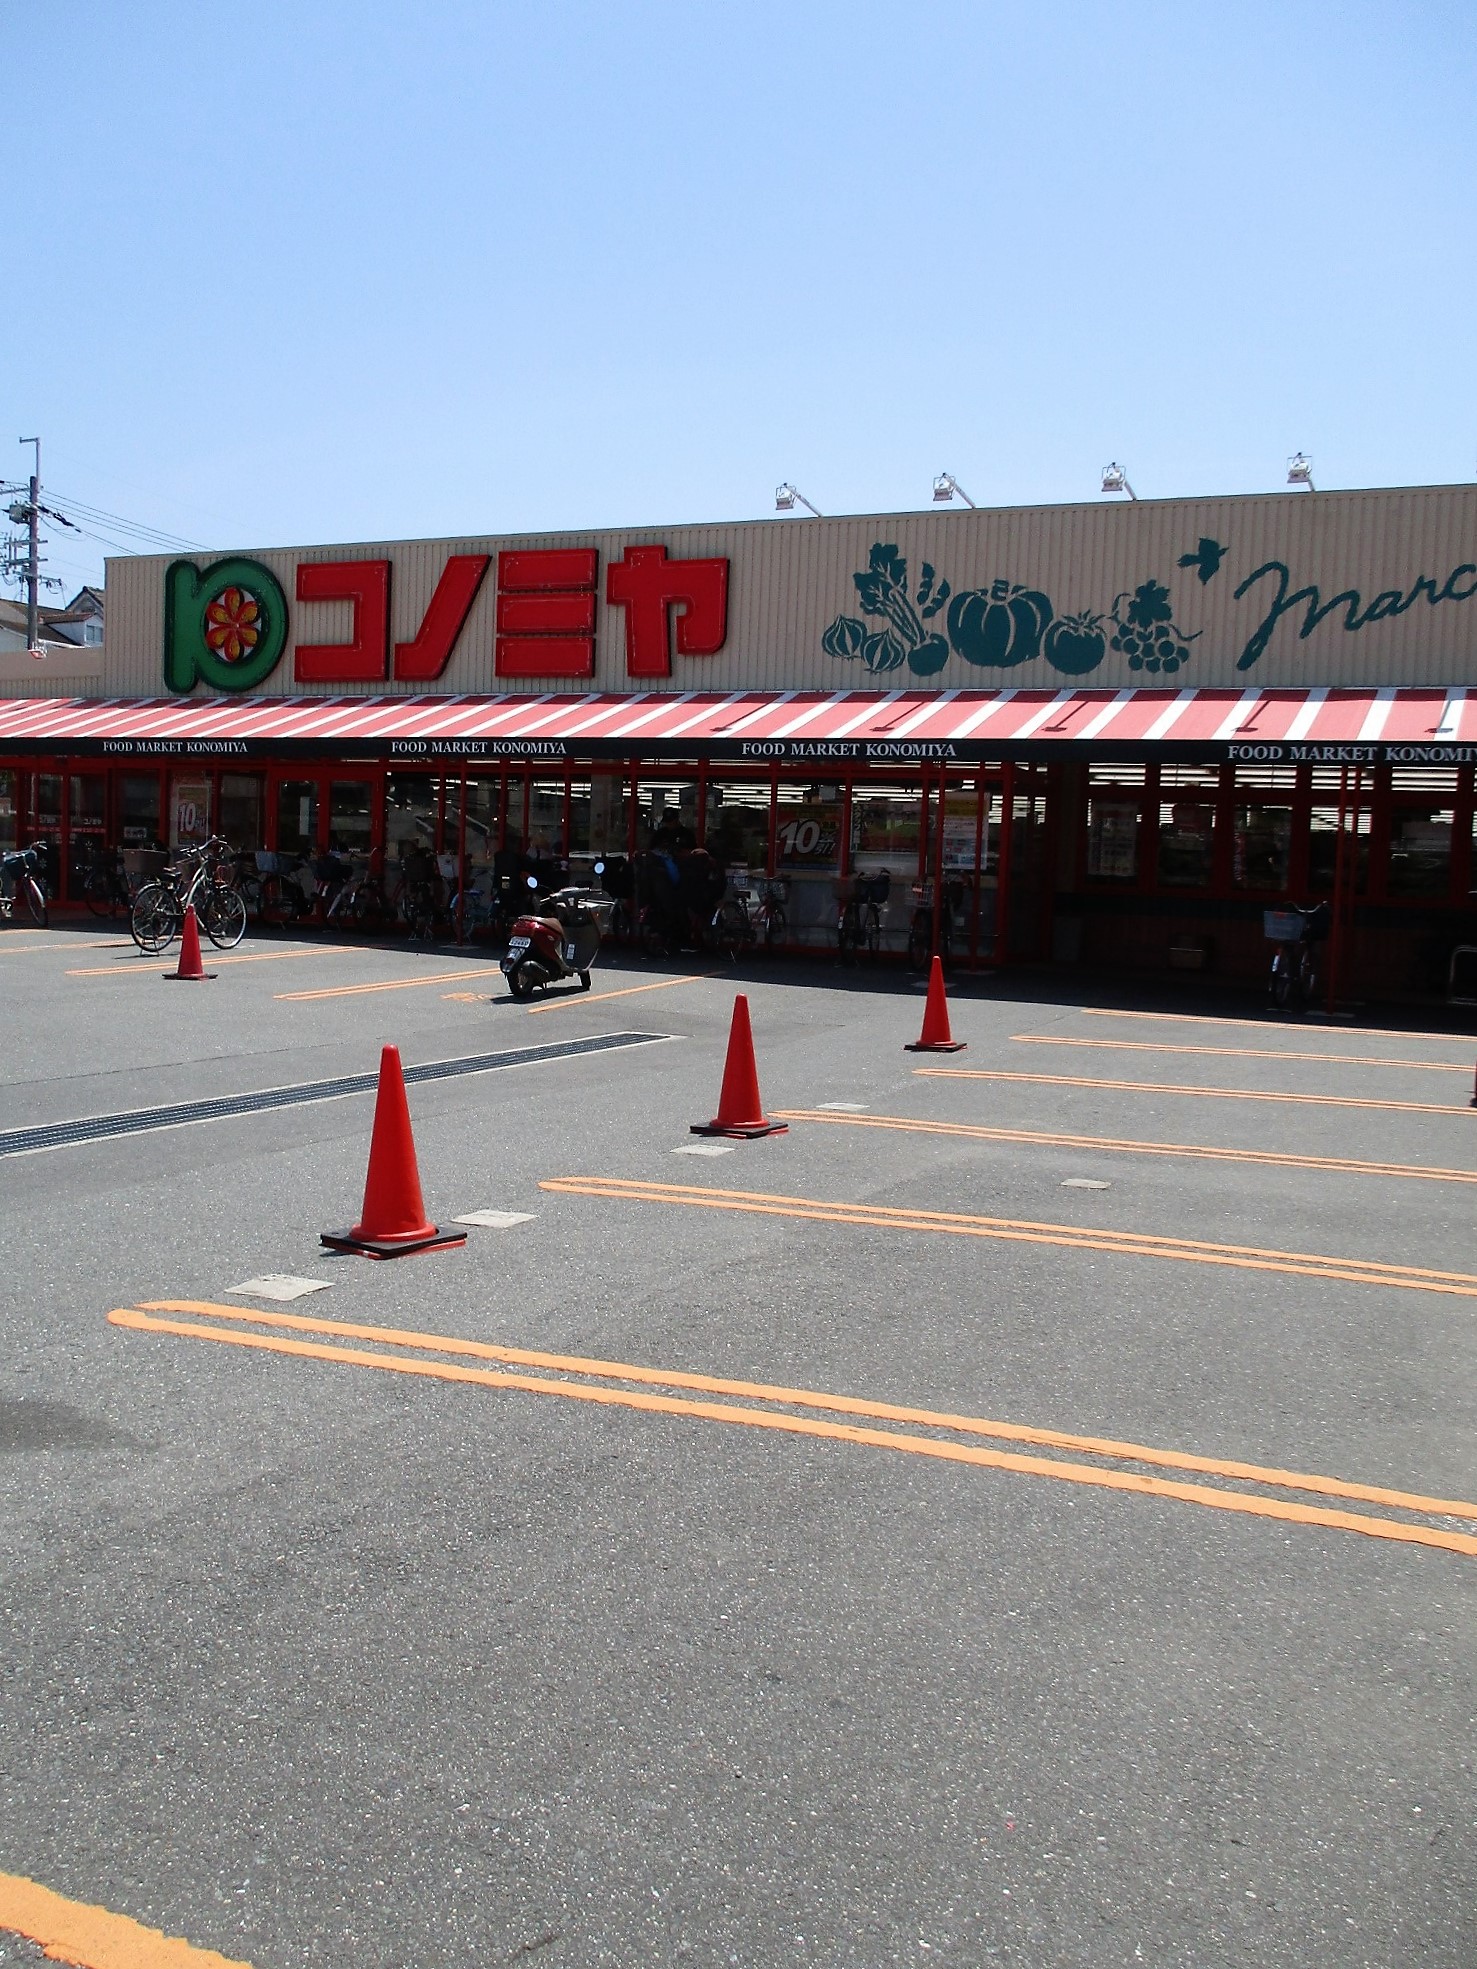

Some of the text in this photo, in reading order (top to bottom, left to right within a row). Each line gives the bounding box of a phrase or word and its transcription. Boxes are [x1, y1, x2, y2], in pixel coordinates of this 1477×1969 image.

[294, 545, 729, 682] コノミヤ
[102, 741, 248, 752] FOOD MARKET KONOMIYA
[391, 741, 567, 754] FOOD MARKET KONOMIYA
[741, 743, 957, 757] FOOD MARKET KONOMIYA
[1227, 744, 1283, 760] FOOD
[1289, 745, 1377, 761] MARKET
[779, 819, 821, 855] 10
